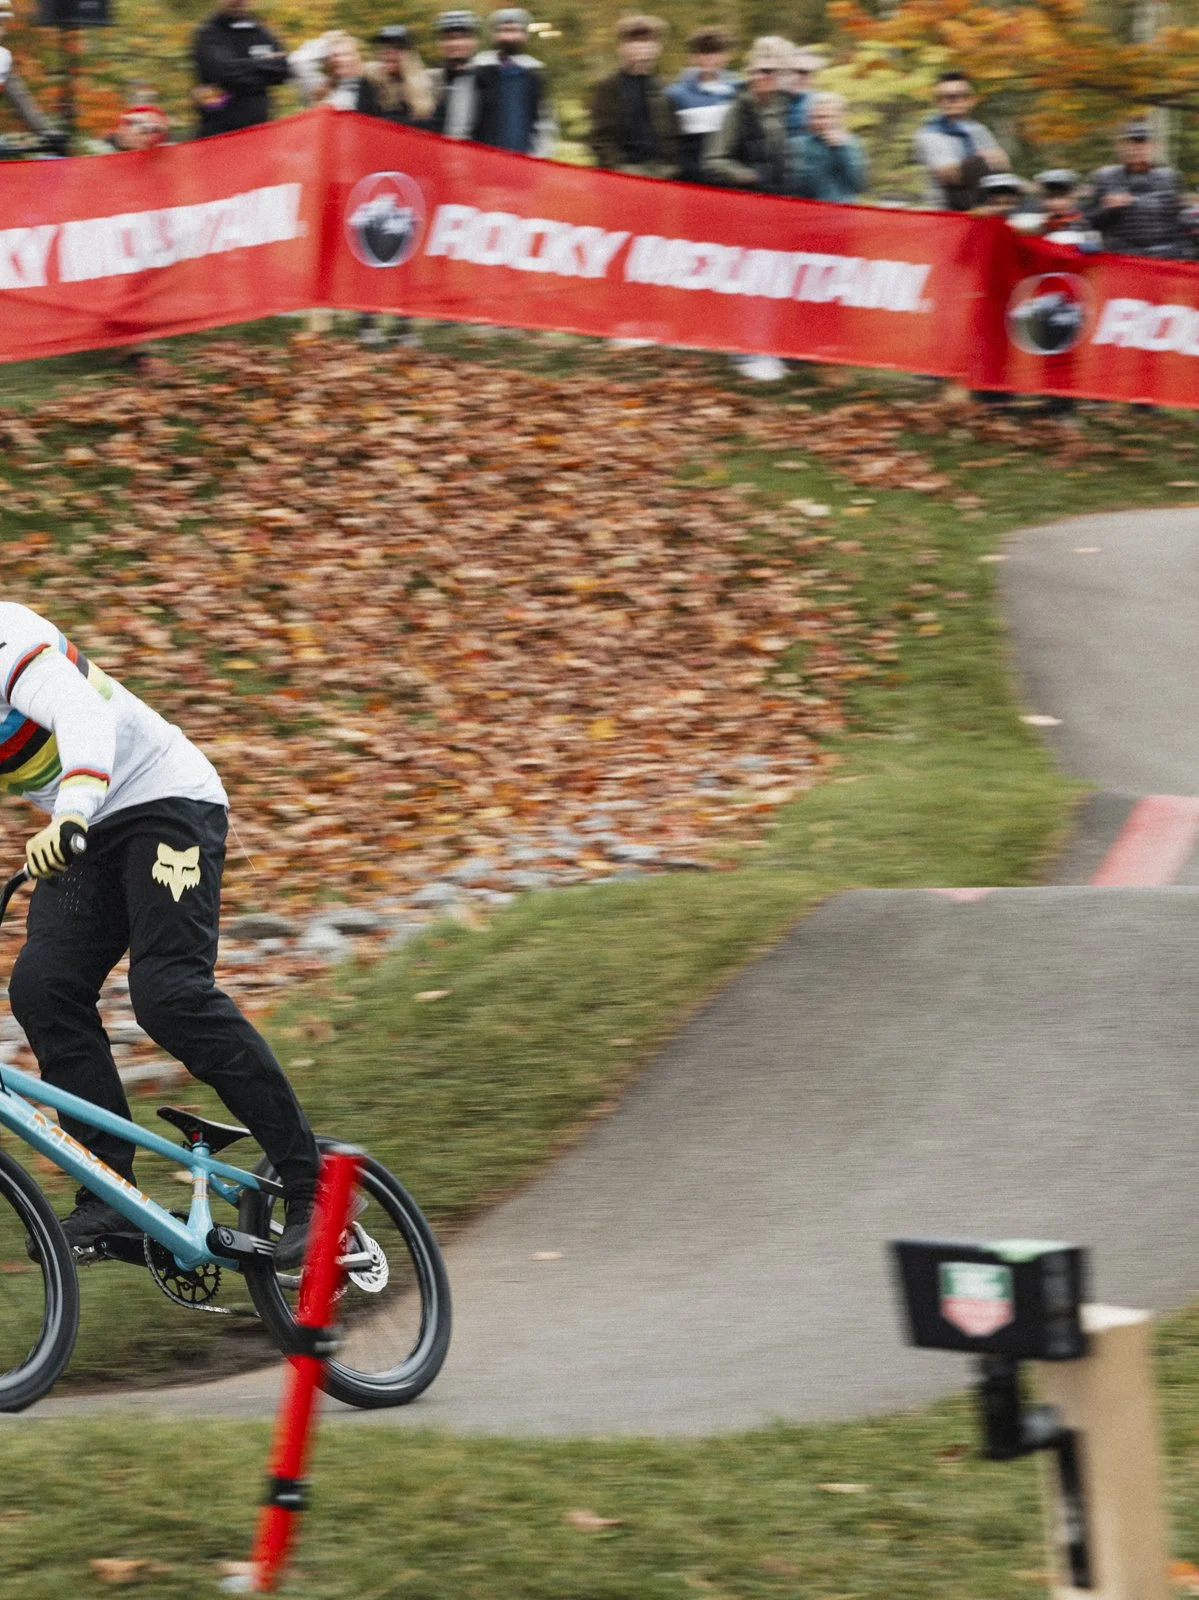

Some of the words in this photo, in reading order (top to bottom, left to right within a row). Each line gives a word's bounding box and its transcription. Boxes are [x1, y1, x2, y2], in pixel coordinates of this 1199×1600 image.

[58, 183, 302, 284] MOUNTAIN
[425, 203, 632, 278] ROCKY
[622, 234, 933, 312] MOUNTAIN
